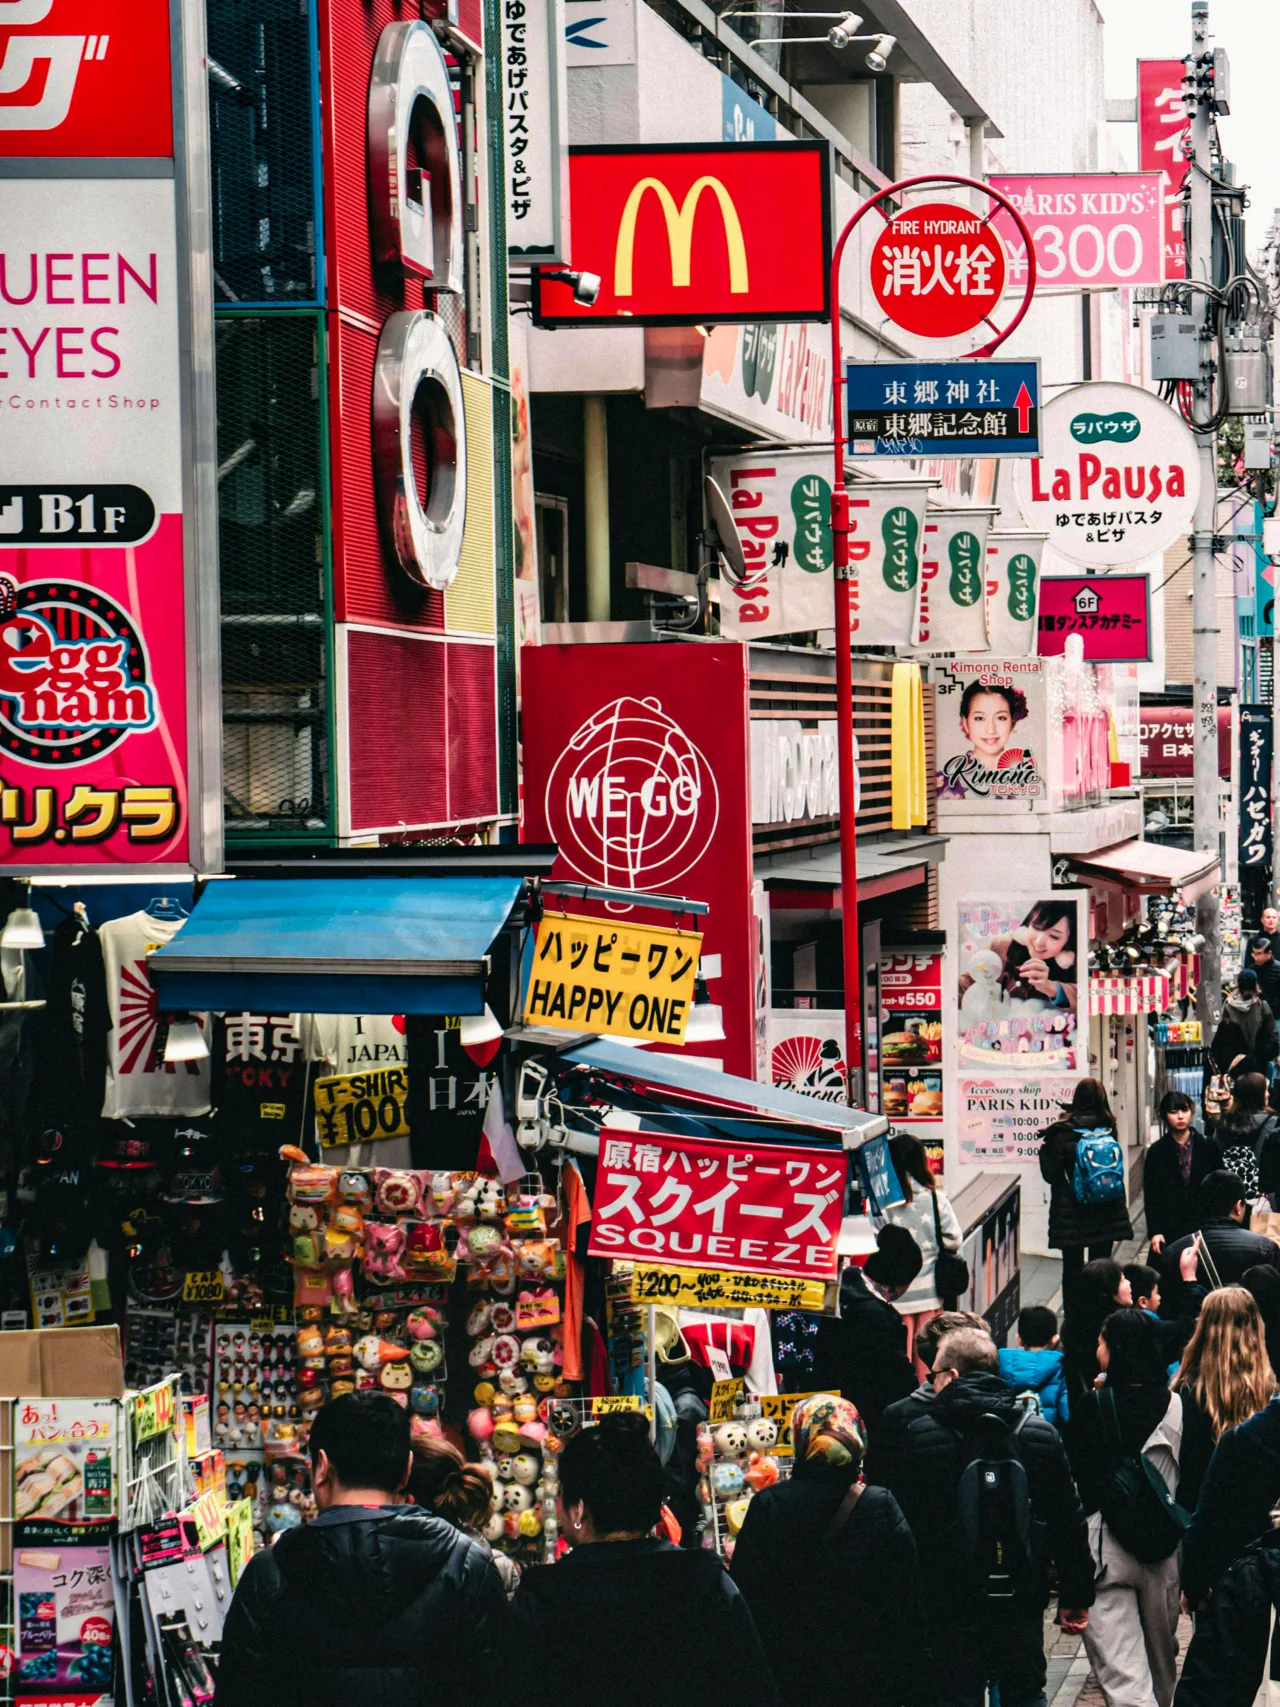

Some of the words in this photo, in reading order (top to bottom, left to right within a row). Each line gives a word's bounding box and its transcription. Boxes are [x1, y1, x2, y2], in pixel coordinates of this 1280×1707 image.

[1006, 187, 1077, 216] PARIS
[1080, 191, 1144, 215] KID'S
[892, 221, 920, 235] FIRE
[924, 220, 983, 235] HYDRANT
[1004, 223, 1144, 280] ¥300
[0, 253, 158, 305] UEEN
[882, 243, 996, 297] 消火栓
[883, 379, 1001, 406] 東郷神社
[855, 419, 877, 432] 原宿
[883, 411, 1008, 439] 東郷記念館
[1078, 452, 1186, 504] Pausa
[39, 493, 127, 534] B1F
[1055, 510, 1163, 528] ゆであげパスタ
[1085, 528, 1126, 543] &ピザ
[1078, 597, 1096, 610] 6F
[949, 660, 999, 673] Kimono
[1003, 660, 1043, 673] Rental
[938, 684, 957, 695] 3F
[979, 673, 1014, 688] Shop
[20, 685, 148, 723] nam
[943, 755, 1042, 796] Kimono
[988, 783, 1041, 795] TOKYO
[1242, 785, 1270, 865] ハセガワ
[539, 930, 694, 984] ハッピーワン
[528, 978, 618, 1027] HAPPY
[628, 991, 686, 1037] ONE
[898, 991, 936, 1006] ¥550
[224, 1012, 303, 1063] 東京
[429, 1071, 498, 1111] 日本
[967, 1085, 1015, 1096] Accessory
[1018, 1085, 1042, 1096] shop
[967, 1098, 1015, 1111] PARIS
[1020, 1098, 1063, 1111] KID'S
[1012, 1117, 1039, 1126] 10:00
[602, 1139, 842, 1190] 原宿ハッピーワン
[1016, 1146, 1039, 1156] 9:00
[598, 1173, 840, 1243] スクイーズ
[594, 1223, 834, 1268] SQUEEZE
[185, 1283, 222, 1300] ¥1080
[190, 1272, 218, 1284] CAP
